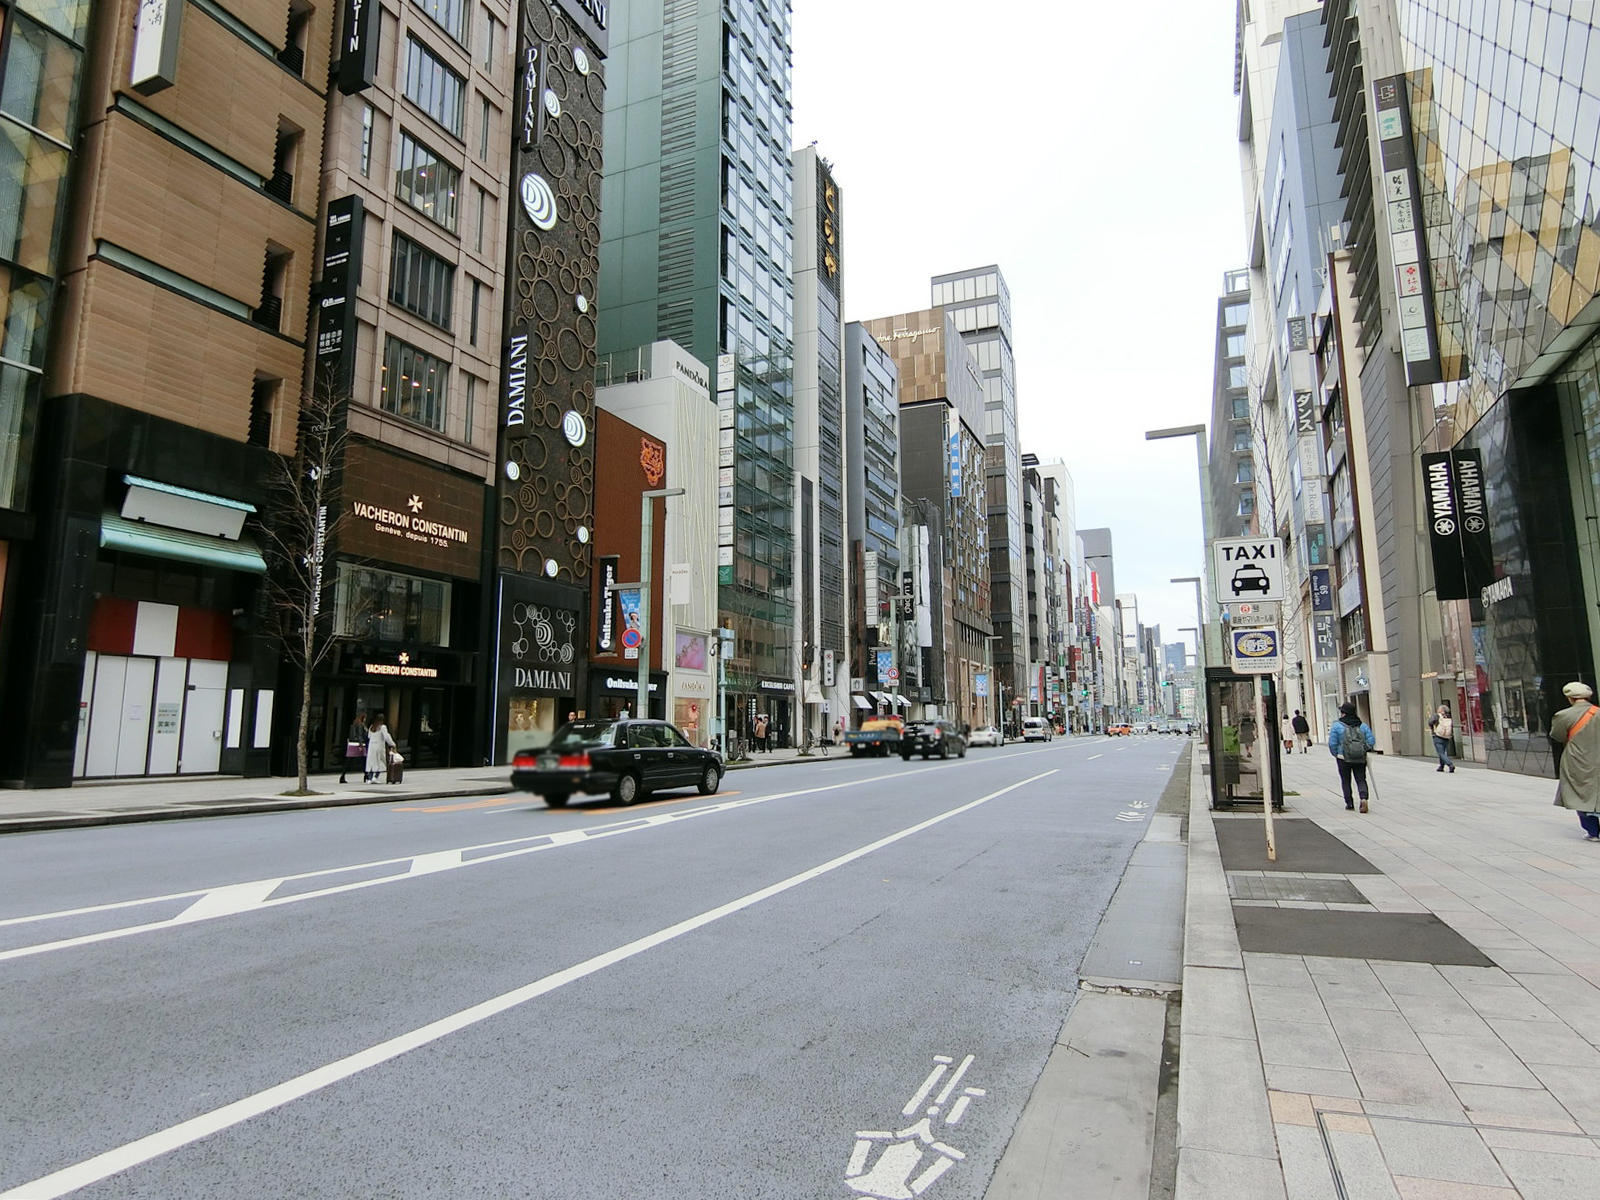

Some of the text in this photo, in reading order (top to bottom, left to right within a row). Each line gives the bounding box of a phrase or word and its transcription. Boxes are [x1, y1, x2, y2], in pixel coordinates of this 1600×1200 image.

[525, 48, 538, 144] DAMIANI
[507, 334, 528, 427] DAMIANI
[1297, 393, 1315, 432] ダンス
[1428, 461, 1453, 518] YAMAHA
[353, 502, 468, 543] VACHERON CONSTANTIN
[406, 531, 428, 543] depuis
[1222, 544, 1276, 561] TAXI
[1487, 575, 1514, 606] YAMAHA
[601, 598, 612, 649] Onitsuka
[365, 663, 437, 677] VACHERON CONSTANTIN
[515, 667, 571, 690] DAMIANI
[606, 677, 638, 690] Onitsuka
